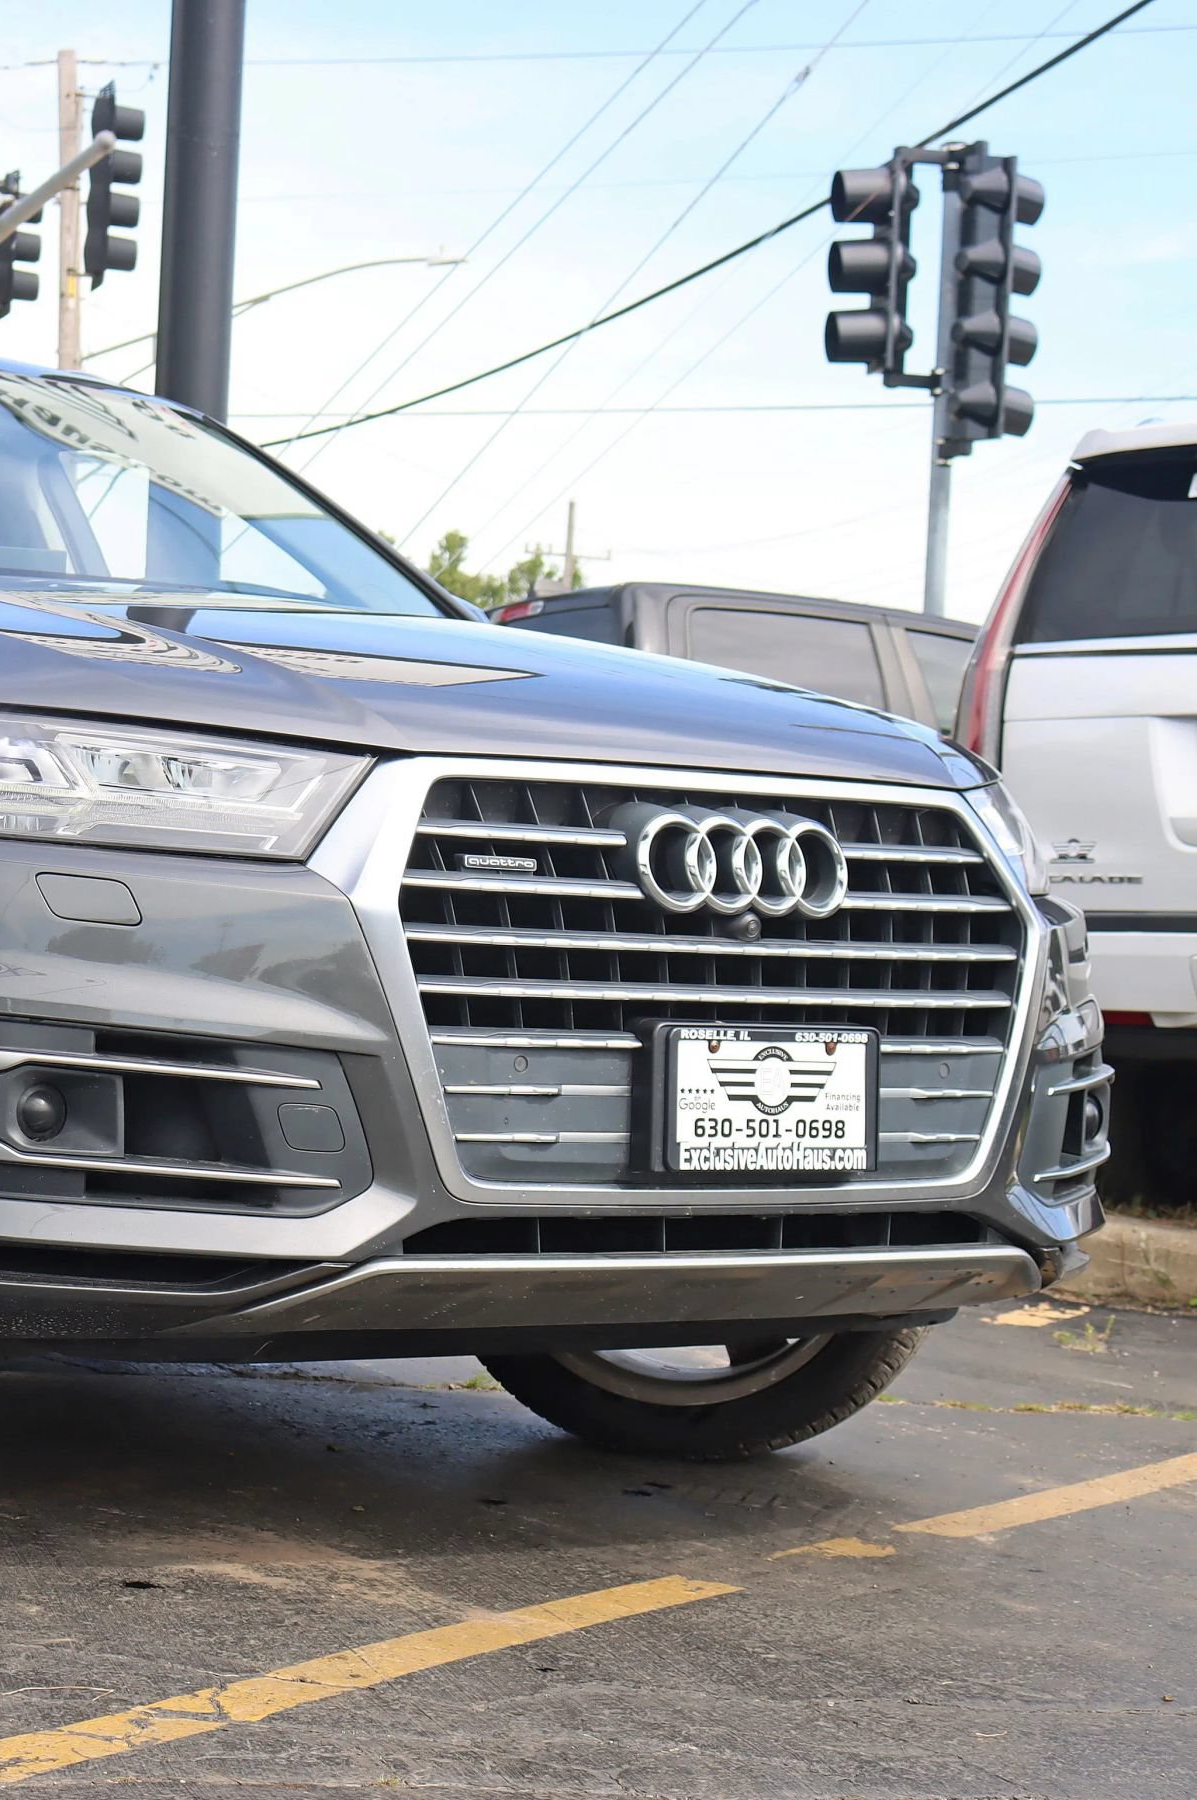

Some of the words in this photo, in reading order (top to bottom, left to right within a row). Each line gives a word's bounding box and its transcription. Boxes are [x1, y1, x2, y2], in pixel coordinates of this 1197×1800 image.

[468, 857, 534, 868] quattro
[1048, 875, 1144, 885] CALADE
[680, 1029, 736, 1041] ROSELLE,
[739, 1030, 752, 1041] IL
[795, 1032, 869, 1044] 630-501-0698
[757, 1048, 789, 1061] EXCLUSIVE
[825, 1092, 861, 1103] Financing
[678, 1097, 716, 1114] Google
[756, 1101, 789, 1114] AUTOHAUS
[826, 1103, 860, 1112] Available
[694, 1118, 846, 1138] 630-501-0698
[679, 1142, 867, 1170] ExclusiveAutoHaus.com
